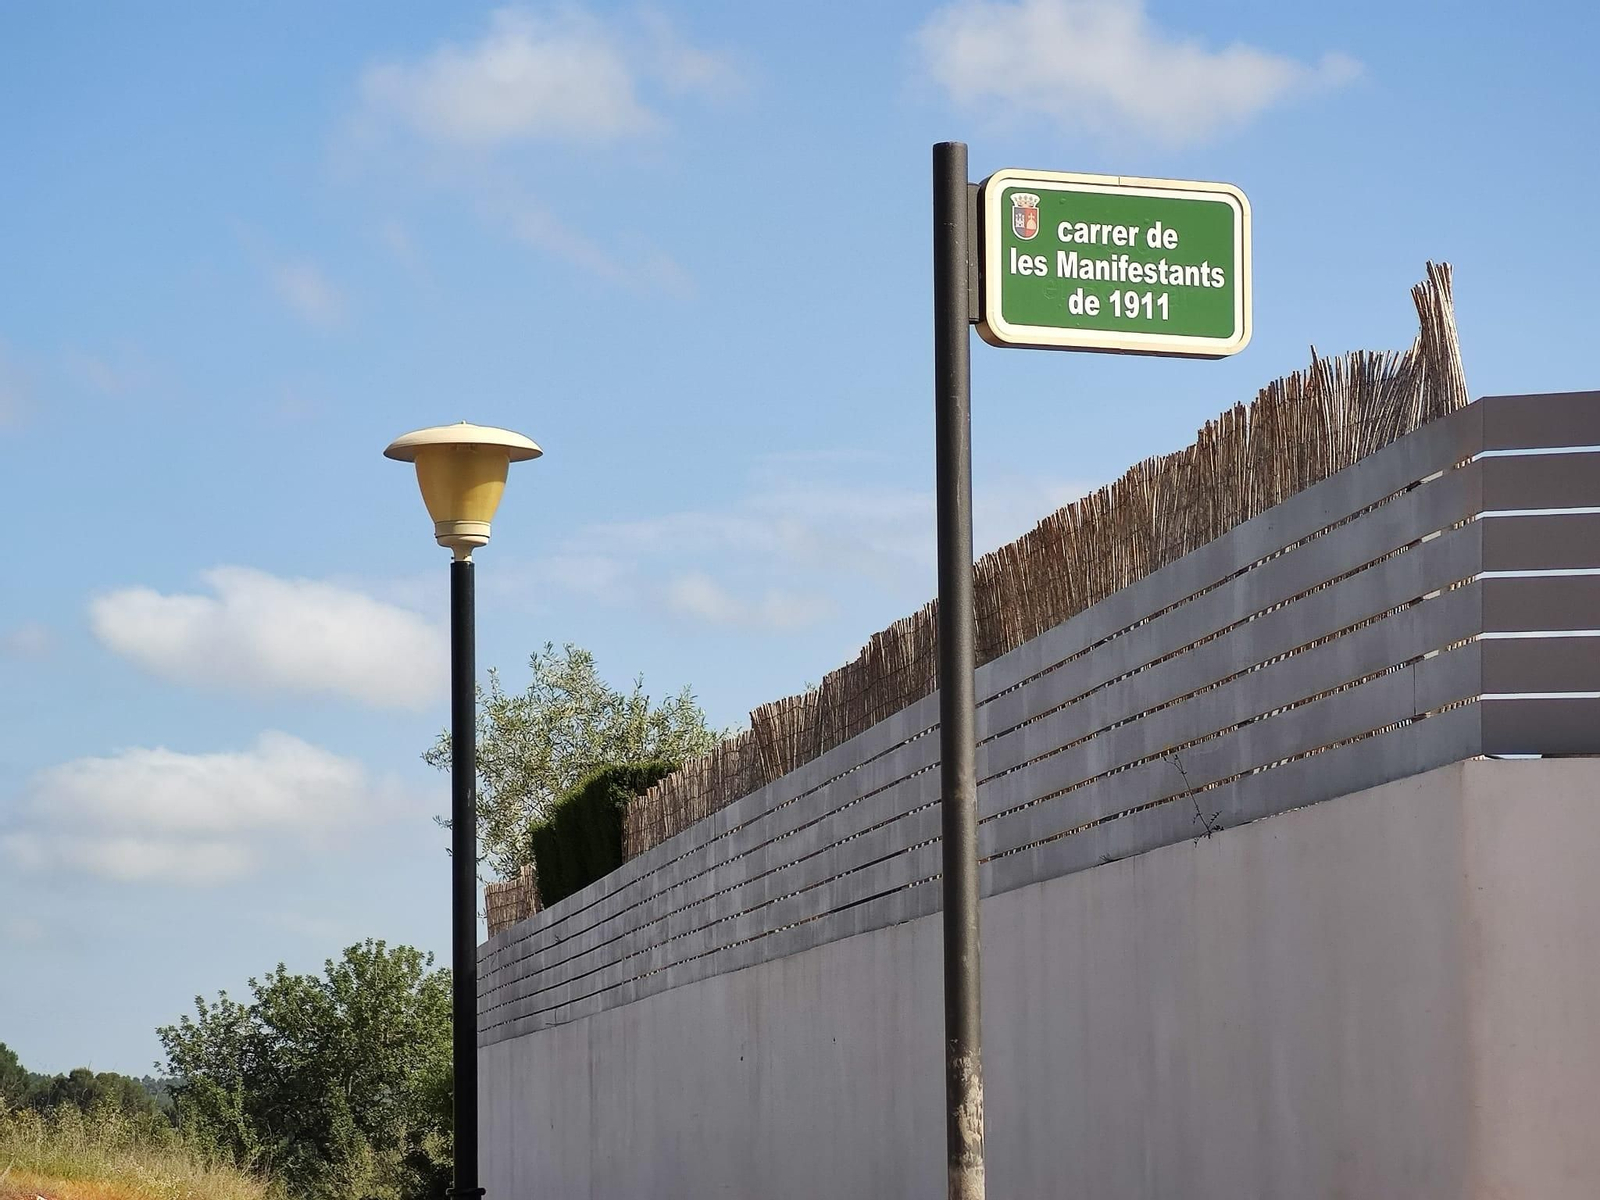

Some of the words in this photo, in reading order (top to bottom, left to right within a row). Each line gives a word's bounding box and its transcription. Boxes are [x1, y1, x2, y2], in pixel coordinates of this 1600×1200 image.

[1057, 221, 1140, 247] carrer
[1146, 220, 1179, 250] de
[1010, 246, 1049, 276] les
[1056, 250, 1225, 289] Manifestants
[1068, 287, 1101, 316] de
[1109, 289, 1169, 321] 1911
